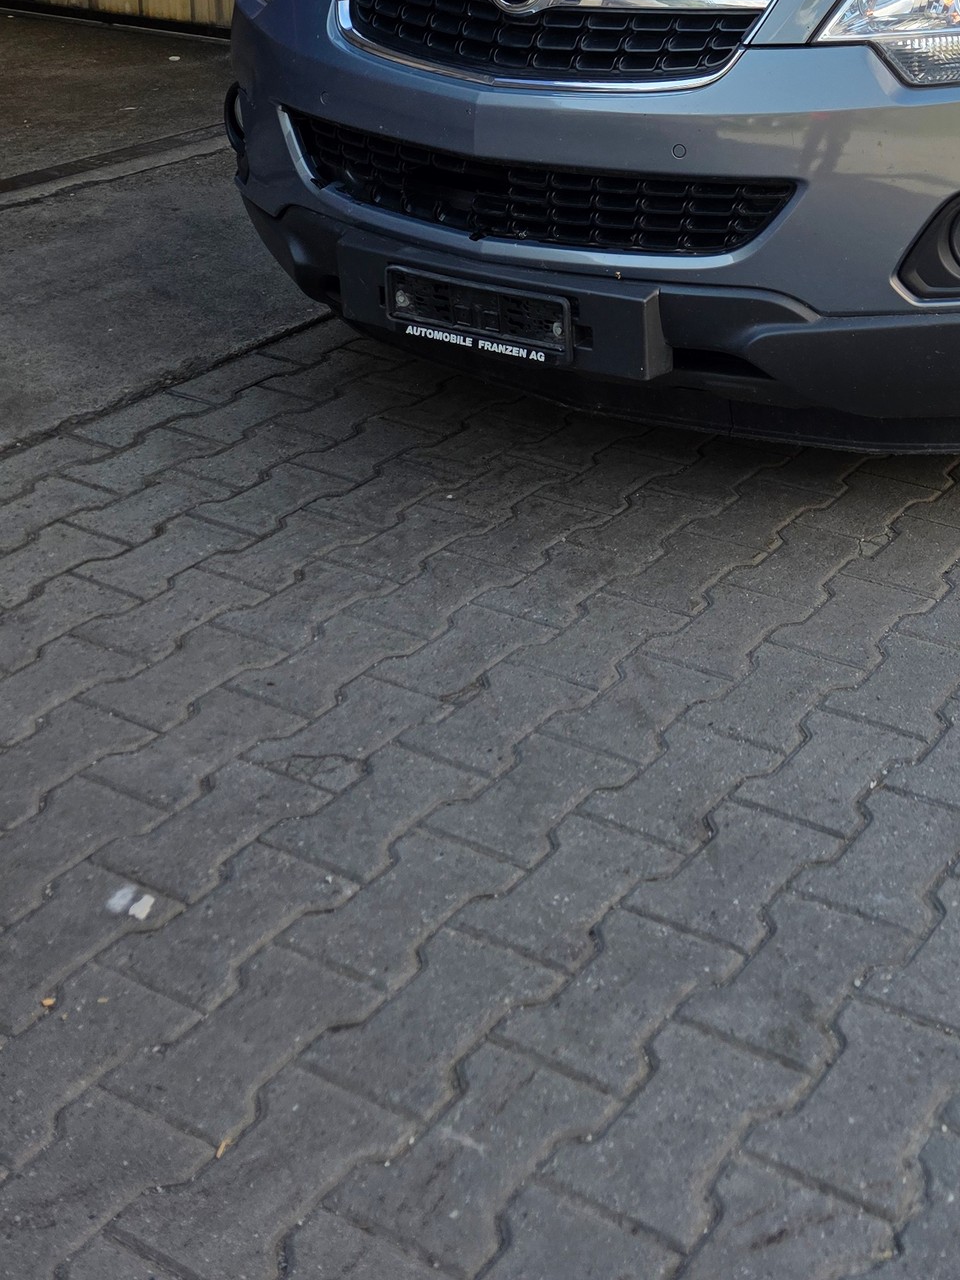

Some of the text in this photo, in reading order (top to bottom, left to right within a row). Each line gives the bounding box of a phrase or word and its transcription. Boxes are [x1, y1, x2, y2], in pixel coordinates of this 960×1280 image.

[405, 325, 546, 362] AUTOMOBILE FRANZEN AG
